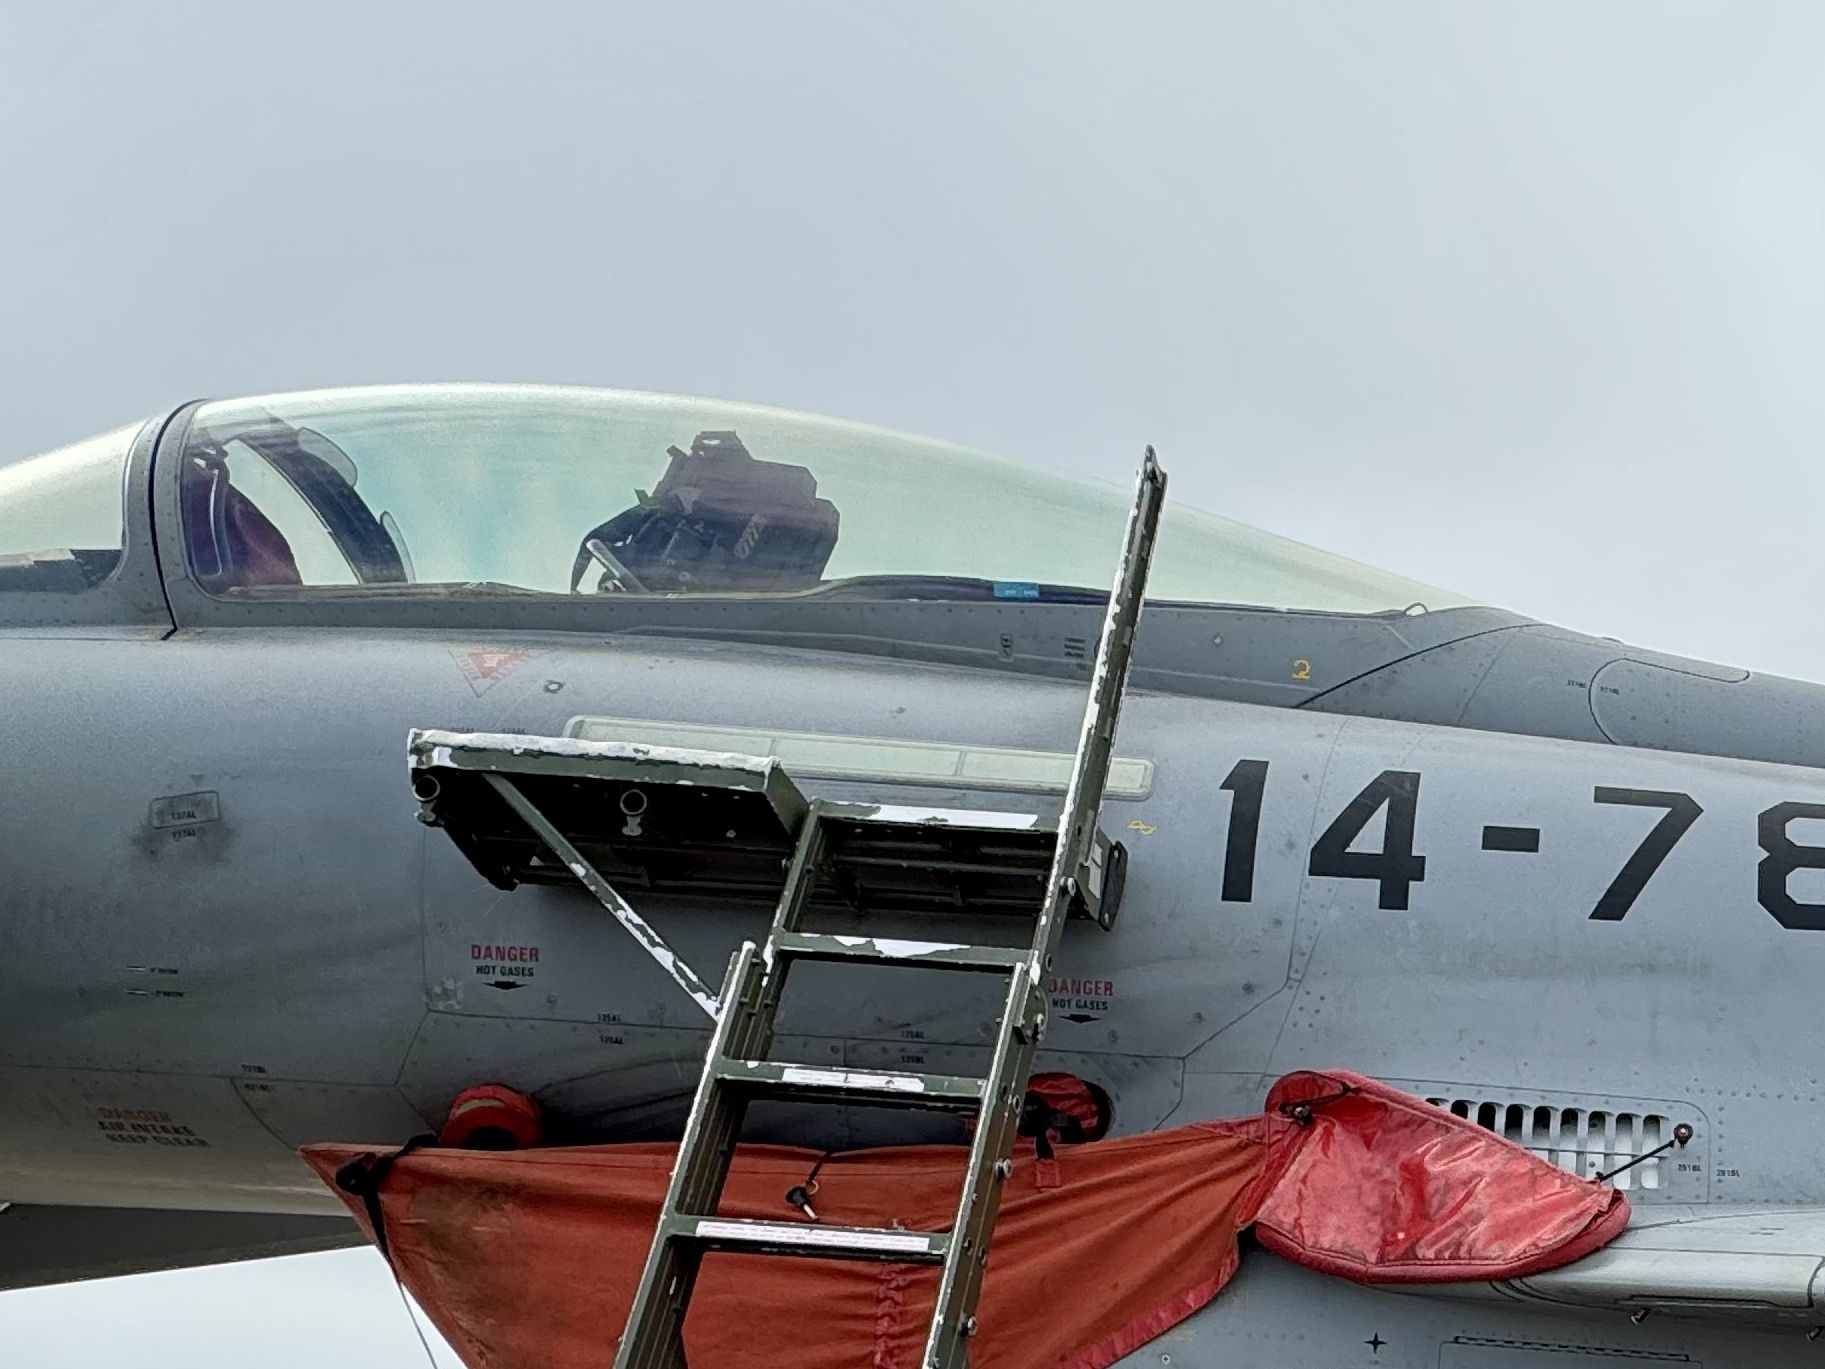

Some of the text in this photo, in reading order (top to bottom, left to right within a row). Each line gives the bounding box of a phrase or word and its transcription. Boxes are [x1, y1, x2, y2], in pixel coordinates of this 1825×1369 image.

[1292, 659, 1311, 680] 2
[471, 944, 539, 962] DANGER
[476, 965, 534, 977] HOT GASES
[1048, 978, 1114, 996] DANGER
[1052, 998, 1109, 1011] HOT GASES
